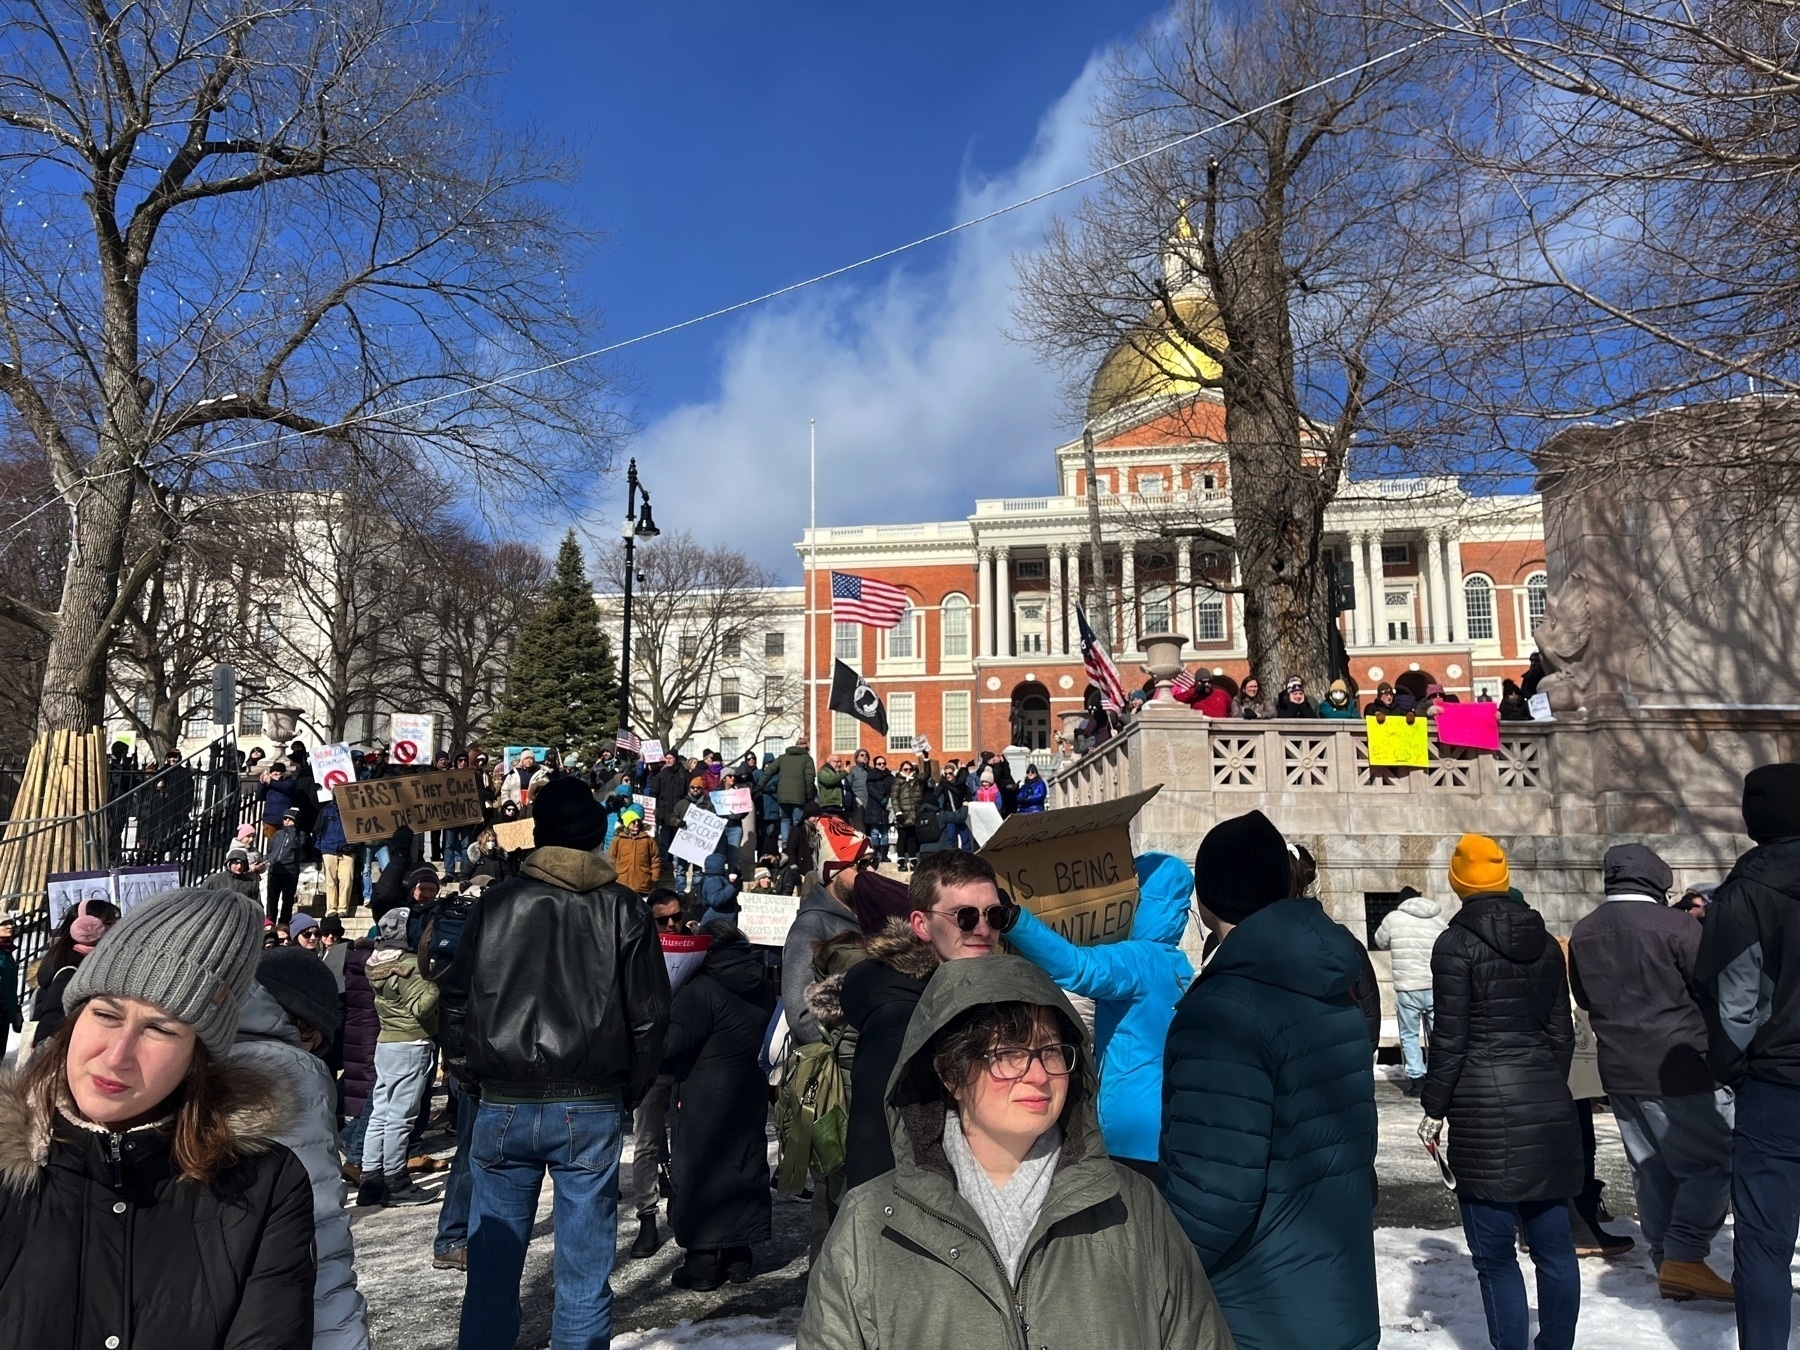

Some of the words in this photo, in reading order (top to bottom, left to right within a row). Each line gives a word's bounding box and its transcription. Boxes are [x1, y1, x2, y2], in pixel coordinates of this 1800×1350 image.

[355, 816, 386, 834] FOR
[391, 807, 412, 827] THE
[687, 807, 705, 821] HEY
[704, 815, 726, 831] ELON
[677, 830, 692, 844] FOR
[696, 825, 719, 841] COUP
[1006, 869, 1034, 903] IS
[1053, 852, 1120, 894] BEING
[743, 895, 761, 904] WHEN
[743, 905, 769, 913] BECOMES
[746, 915, 789, 925] RESISTANCE
[744, 926, 772, 935] BECOMES
[661, 936, 695, 947] husetts
